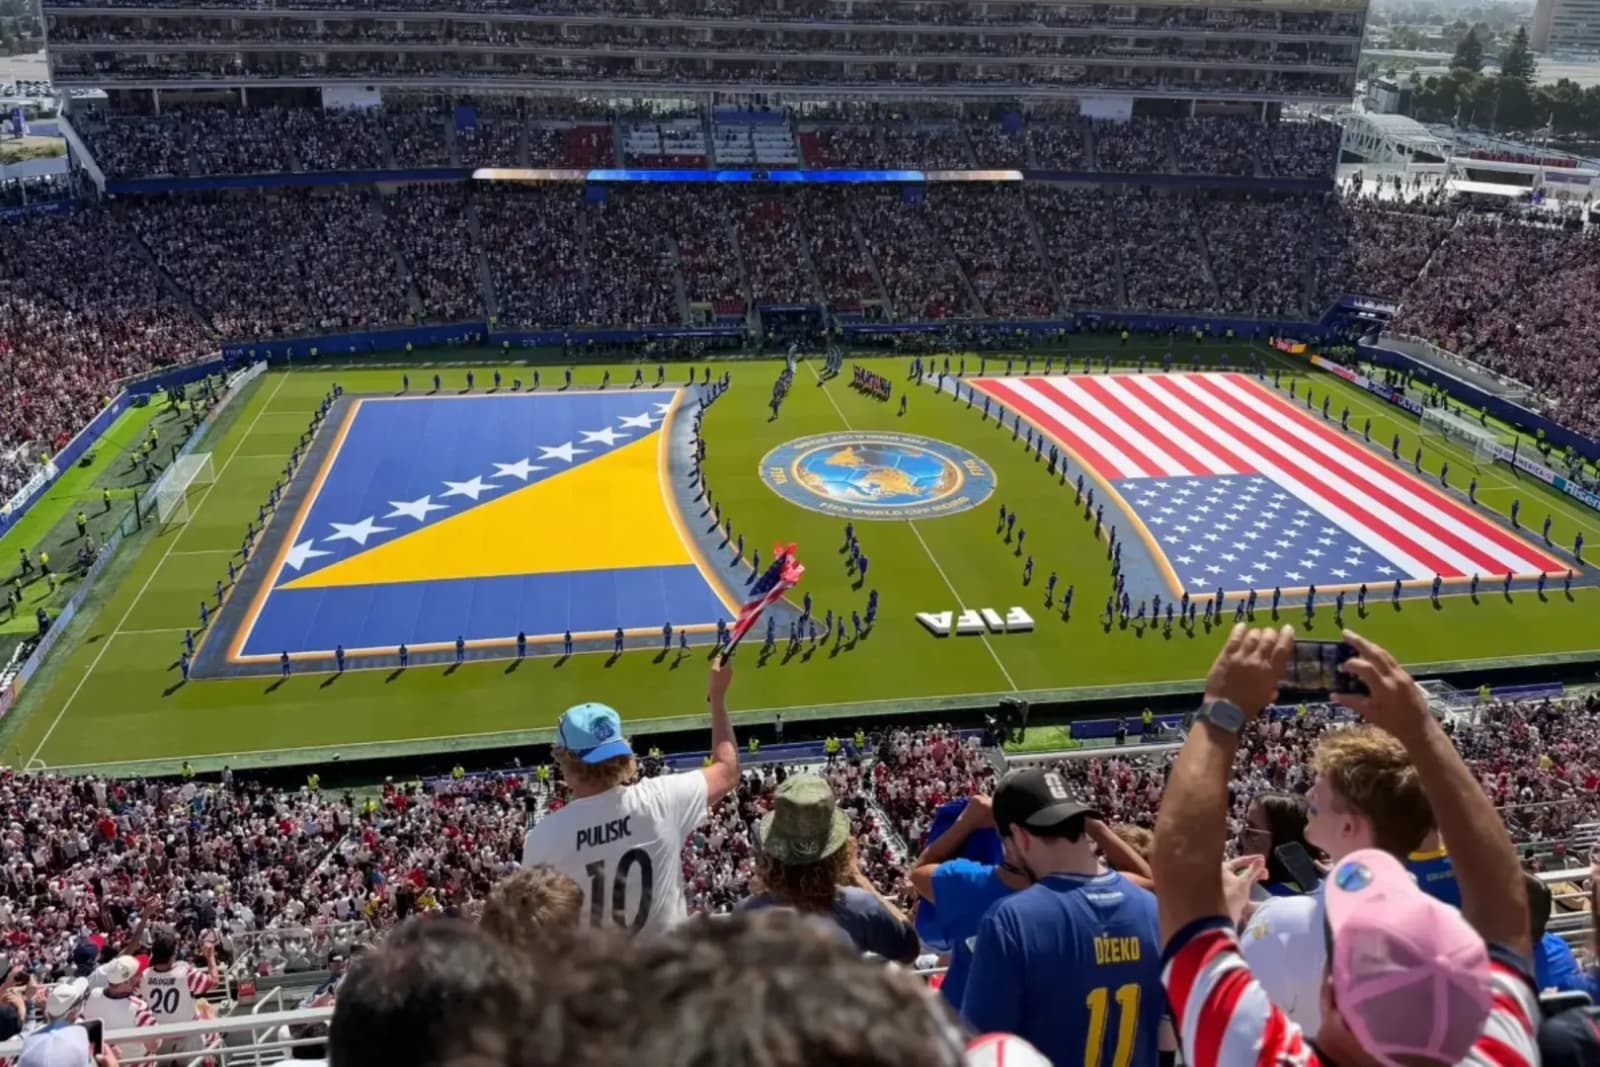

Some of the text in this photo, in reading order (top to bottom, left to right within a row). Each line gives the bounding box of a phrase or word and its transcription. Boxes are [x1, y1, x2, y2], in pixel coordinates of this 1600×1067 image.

[1512, 456, 1544, 476] MERICA
[914, 605, 1035, 634] FIFA
[576, 815, 632, 850] PULISIC
[585, 847, 653, 935] 10
[1093, 933, 1141, 965] DŽEKO
[150, 987, 180, 1014] 20
[1083, 983, 1141, 1067] 11
